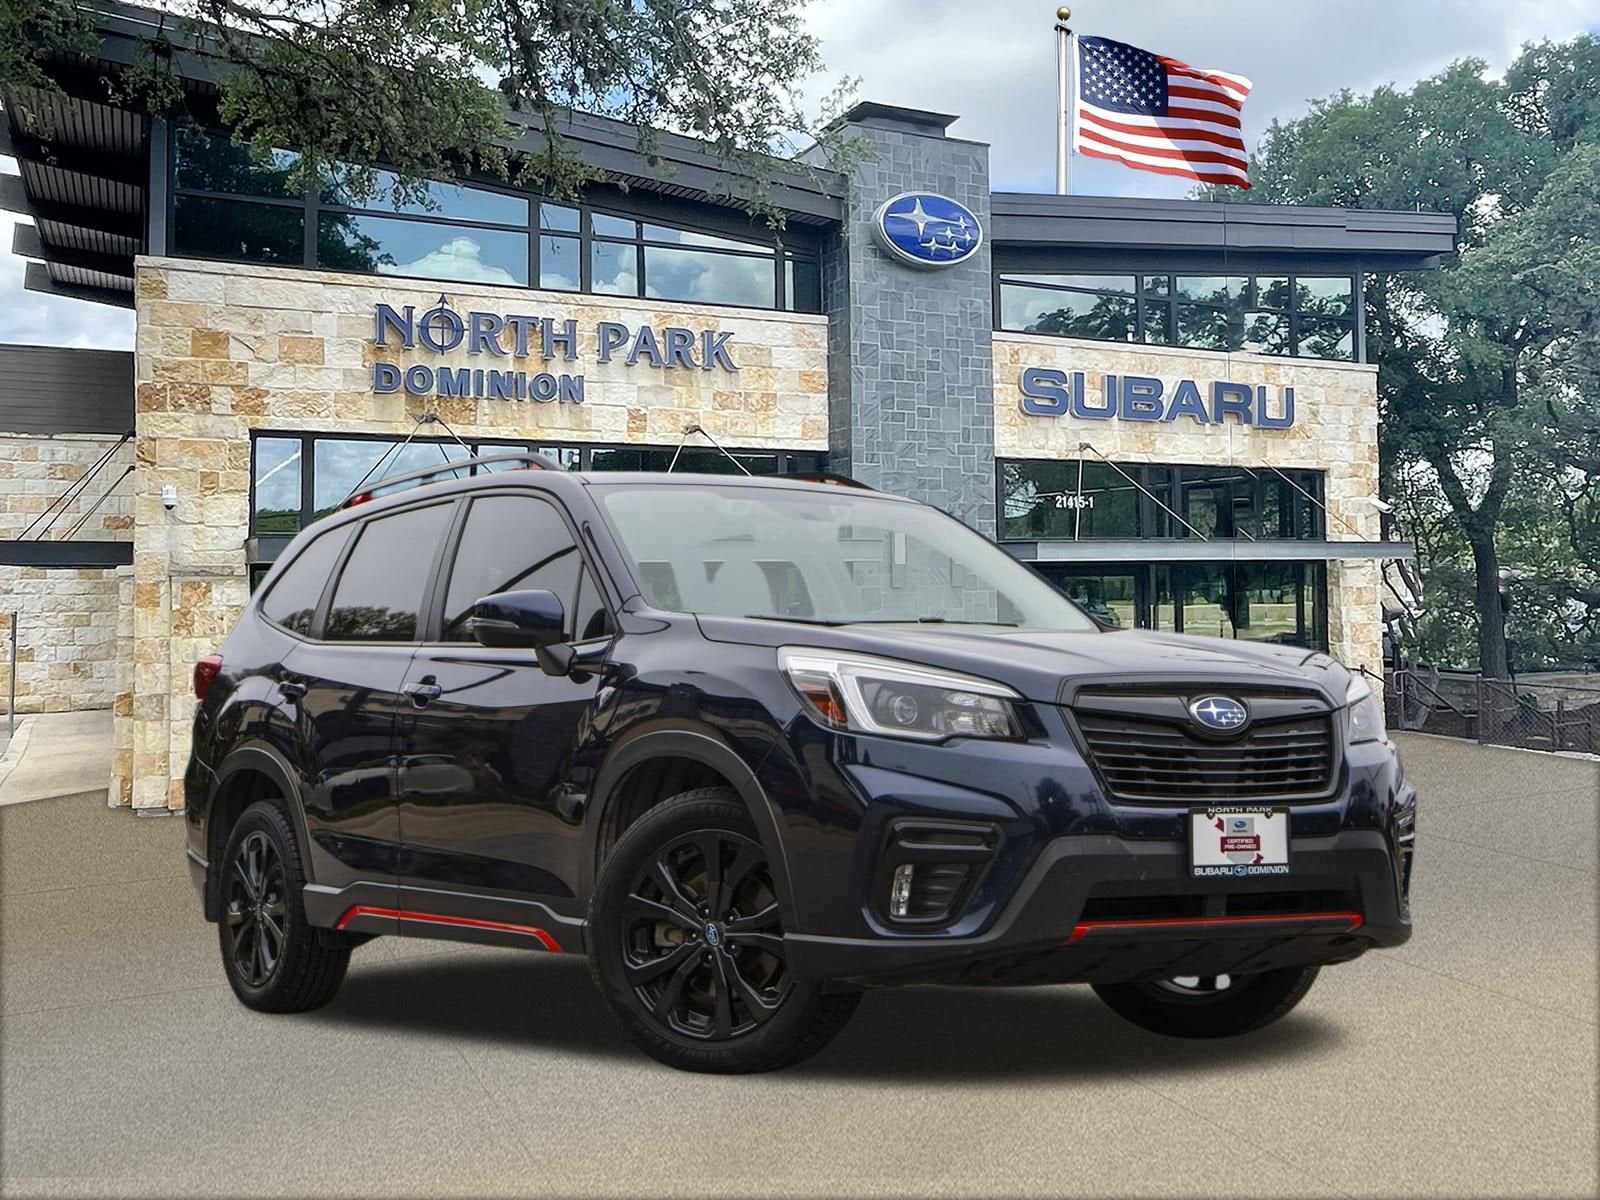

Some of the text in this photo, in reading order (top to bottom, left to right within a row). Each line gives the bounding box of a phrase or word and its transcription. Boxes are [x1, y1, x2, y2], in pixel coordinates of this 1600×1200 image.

[375, 292, 741, 373] NORTH PARK
[373, 362, 585, 404] DOMINION
[1019, 367, 1294, 429] SUBARU
[1194, 865, 1289, 876] SUBARU DOMINION
